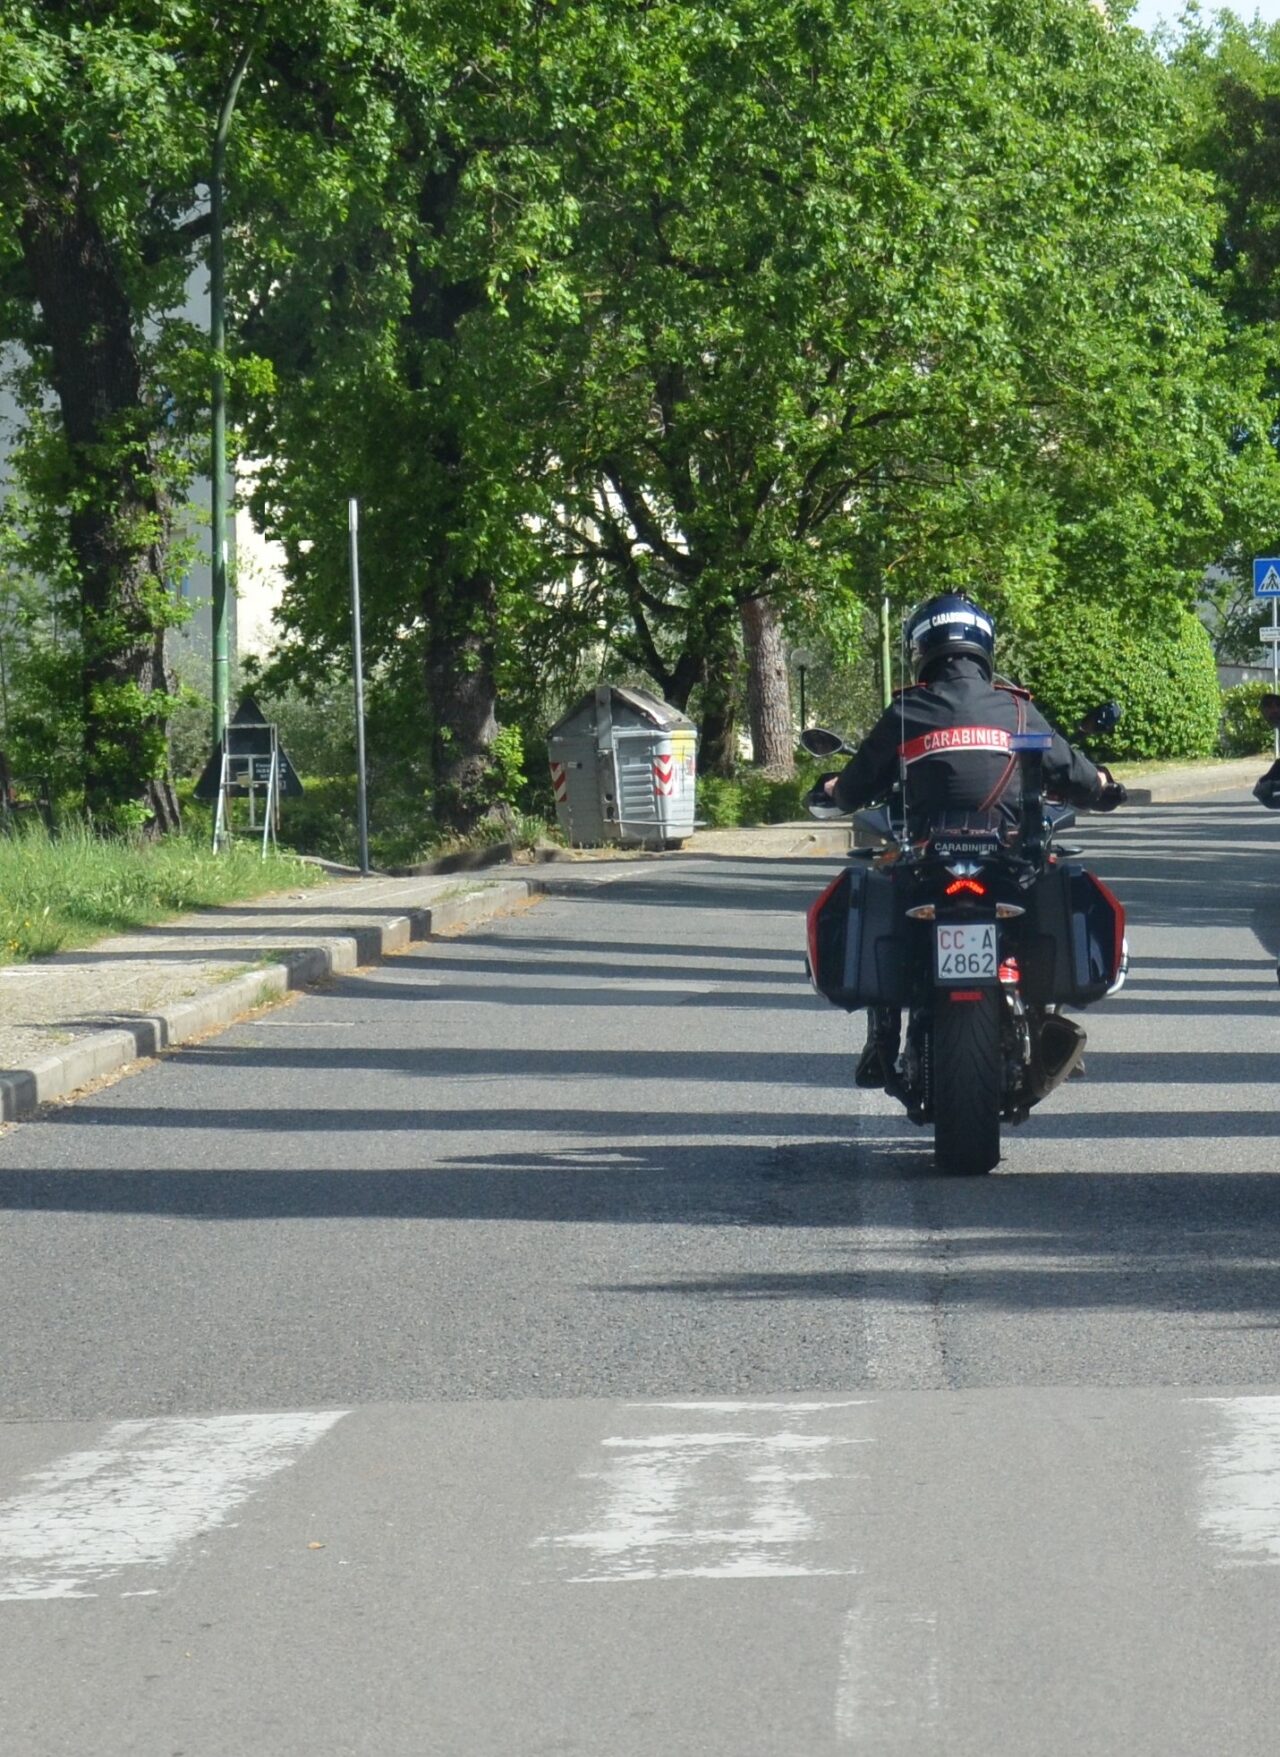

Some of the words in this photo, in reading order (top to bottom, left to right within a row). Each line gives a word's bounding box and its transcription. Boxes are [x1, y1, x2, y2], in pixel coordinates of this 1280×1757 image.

[924, 729, 1010, 750] CARABINIER
[934, 843, 998, 852] CARABINIERI
[940, 930, 965, 950] CC
[982, 929, 993, 950] A
[941, 952, 994, 974] 4862
